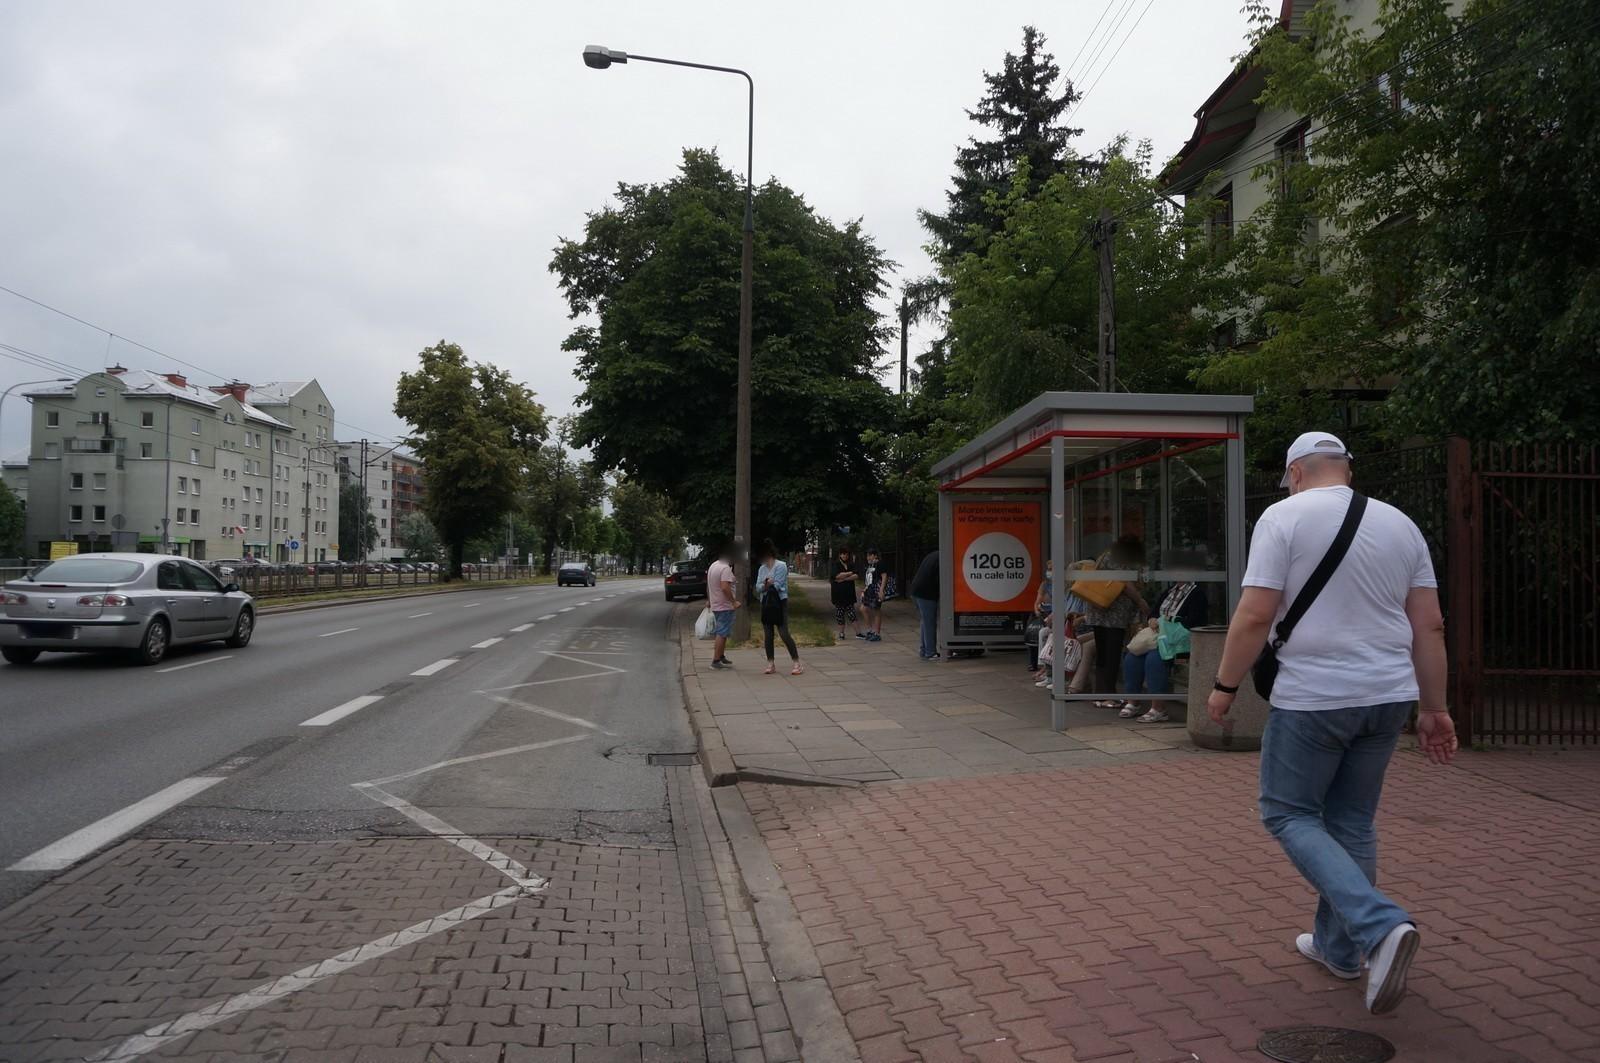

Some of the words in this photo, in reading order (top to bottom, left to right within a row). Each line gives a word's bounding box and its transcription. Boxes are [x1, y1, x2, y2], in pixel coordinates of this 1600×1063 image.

[968, 515, 998, 525] Orange
[970, 553, 1001, 569] 120
[1003, 556, 1025, 569] GB
[970, 572, 982, 580] na
[1006, 571, 1025, 580] lato
